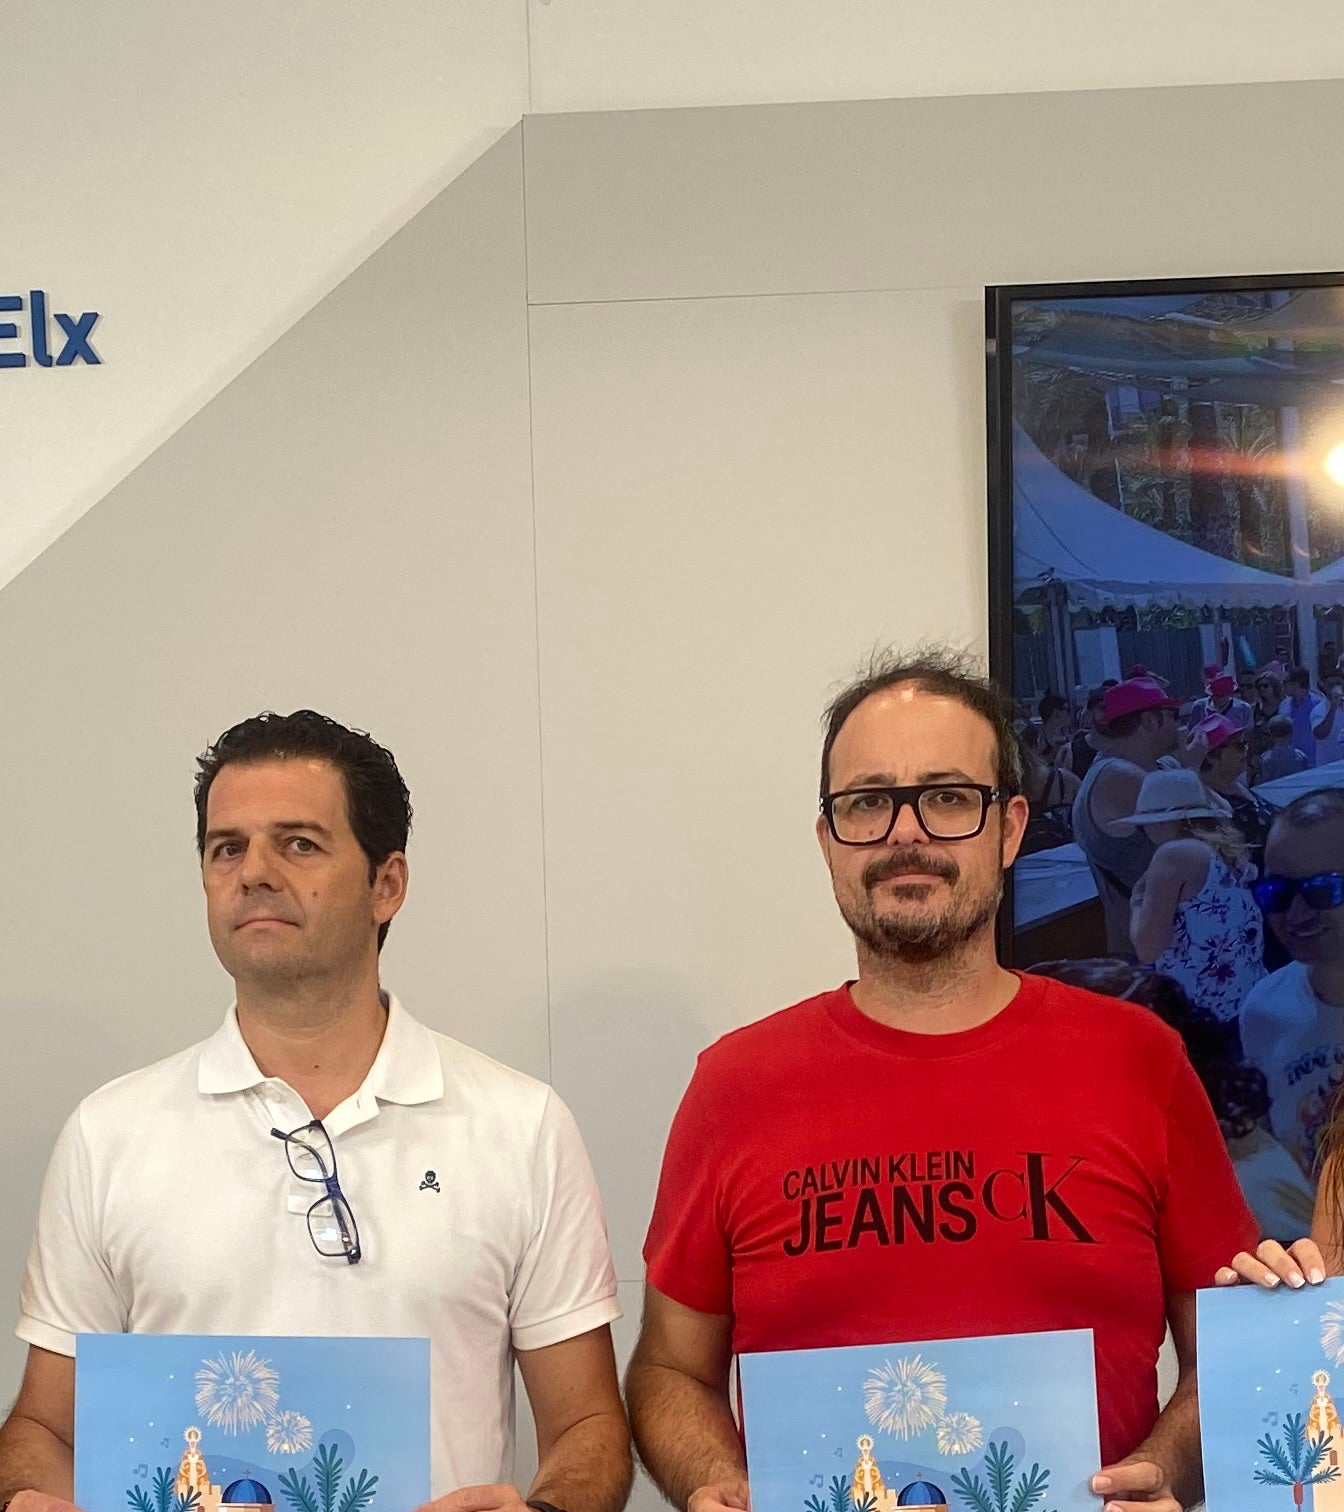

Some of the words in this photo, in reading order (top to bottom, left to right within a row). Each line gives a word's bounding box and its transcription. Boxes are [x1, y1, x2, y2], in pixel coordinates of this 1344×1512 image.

[783, 1156, 880, 1200] CALVIN
[888, 1151, 975, 1183] KLEIN
[783, 1184, 977, 1257] JEANS
